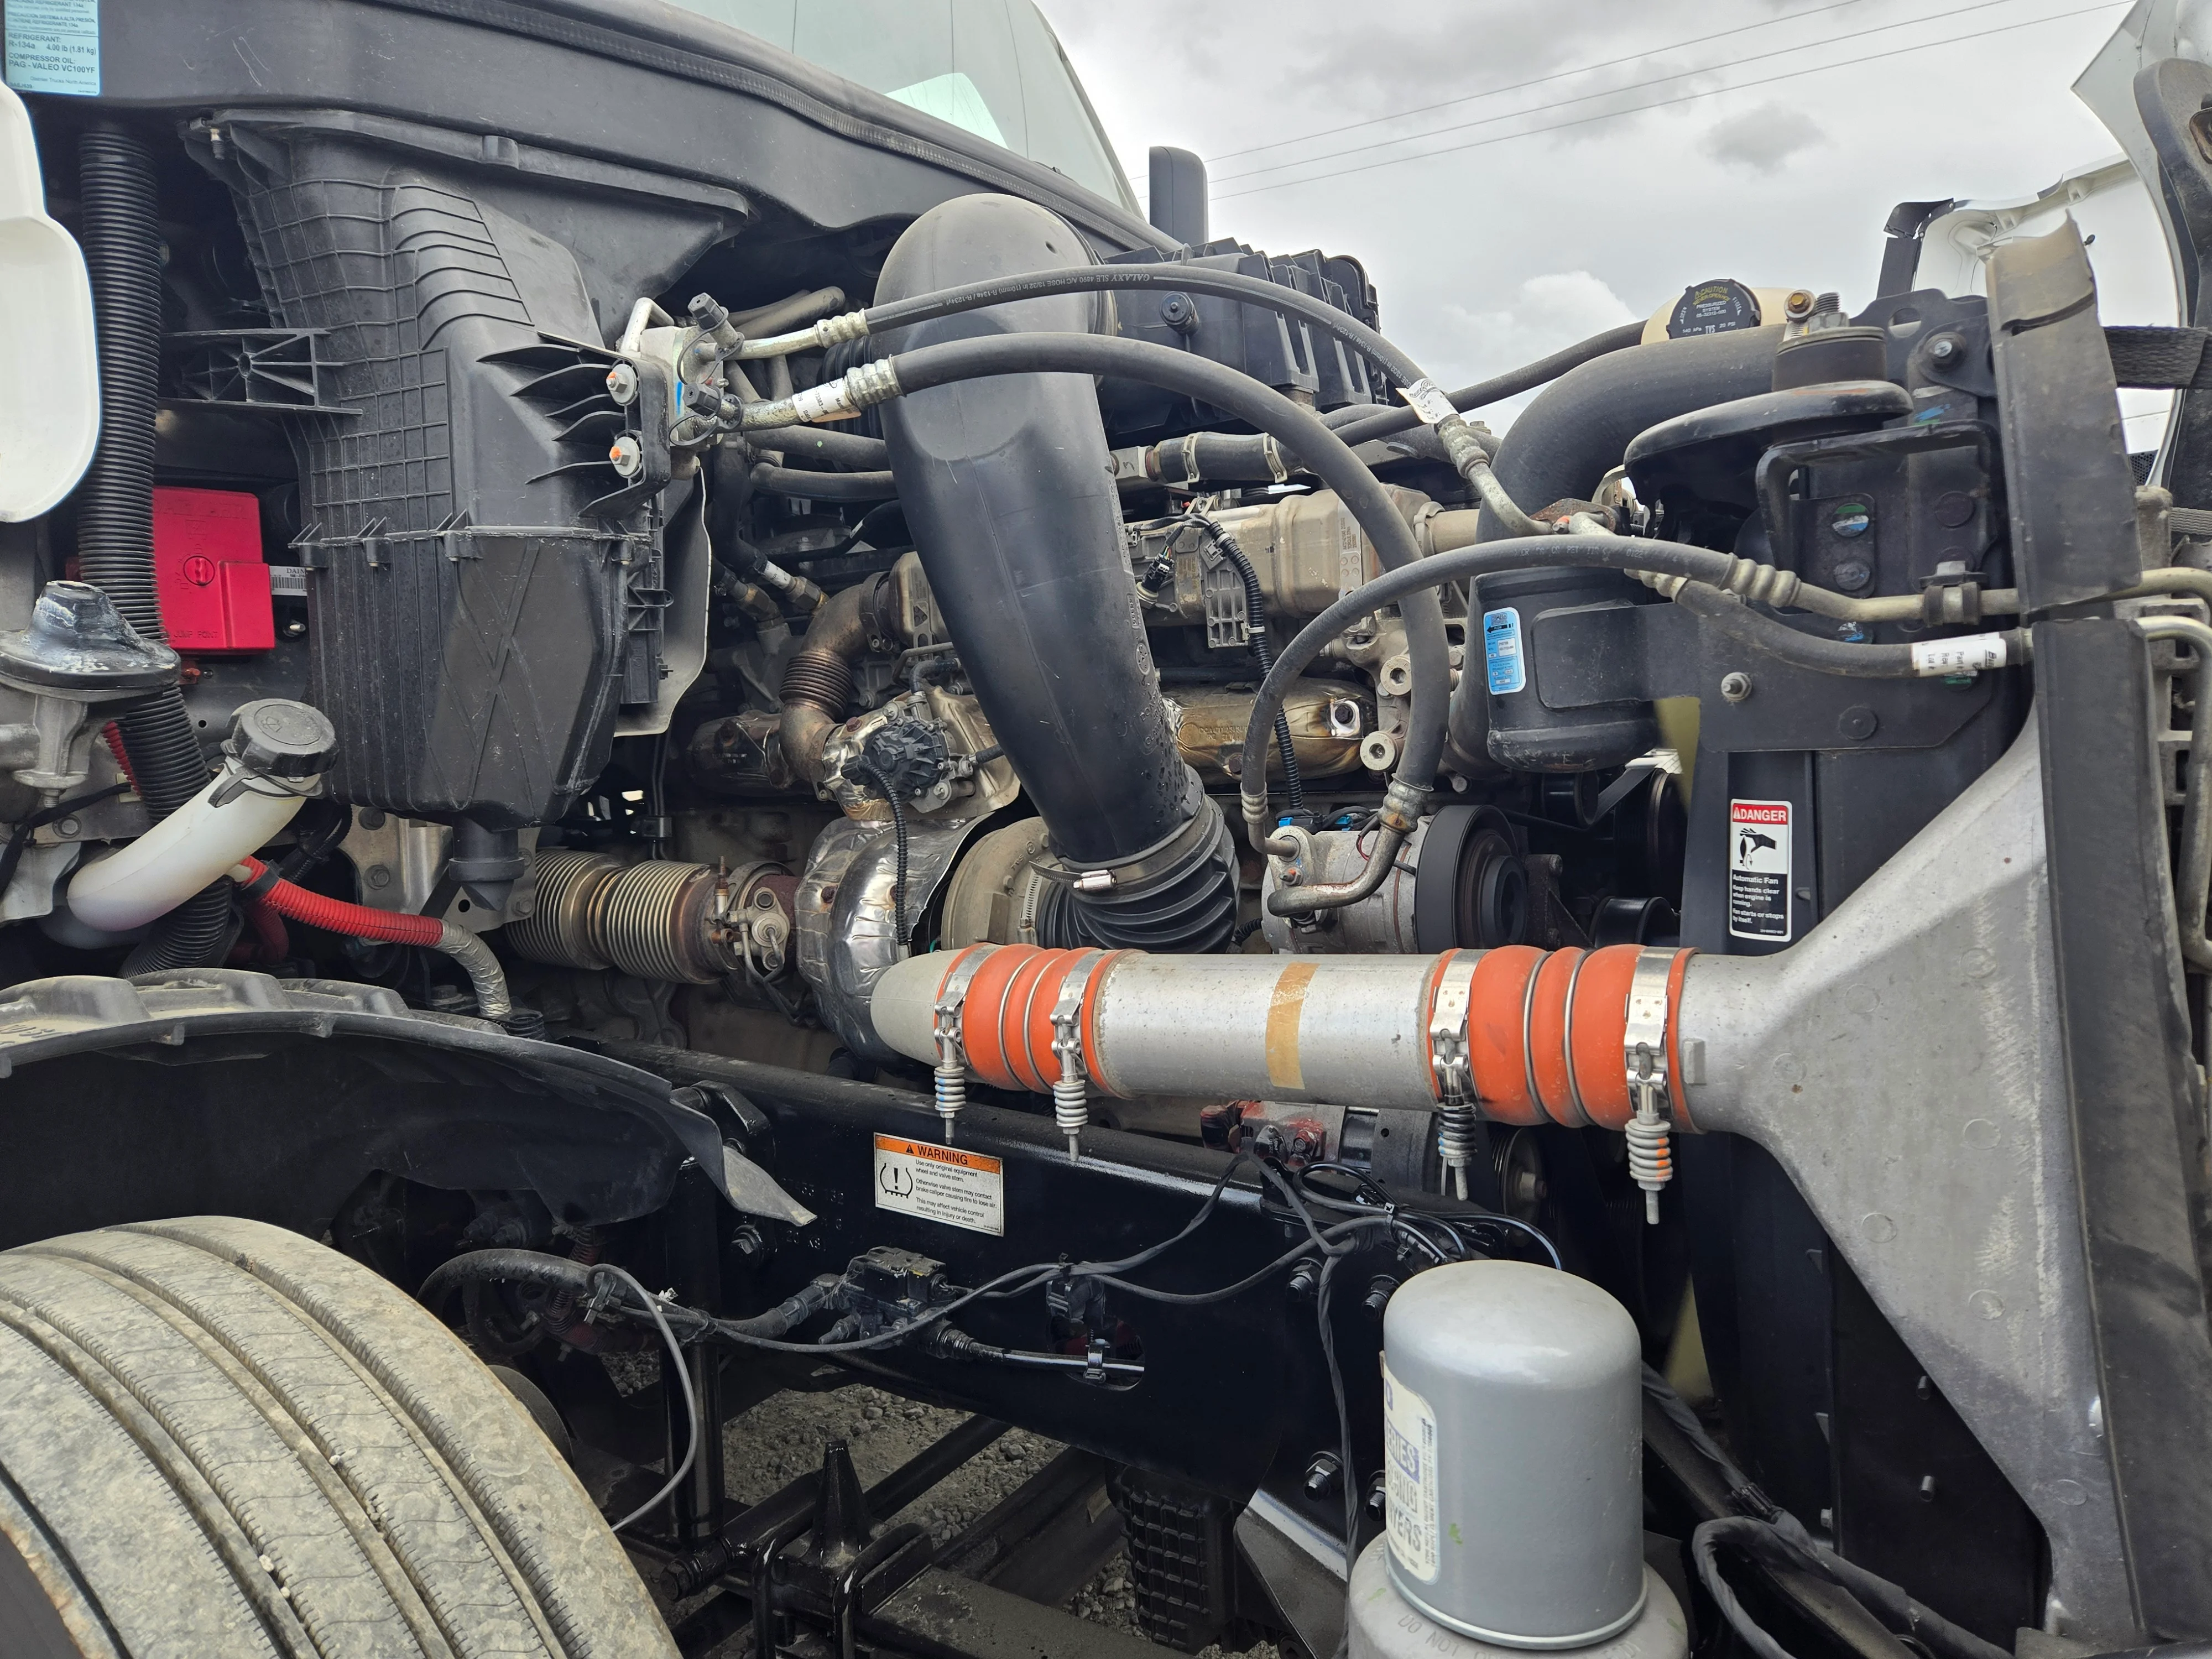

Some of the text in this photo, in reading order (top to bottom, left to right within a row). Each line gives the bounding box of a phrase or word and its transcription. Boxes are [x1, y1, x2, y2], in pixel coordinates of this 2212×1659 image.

[8, 33, 61, 43] REFRIGERANT:
[8, 40, 35, 49] R-134a
[69, 45, 84, 54] (1.81
[86, 46, 96, 55] kg)
[8, 53, 60, 63] COMPRESSOR
[8, 59, 26, 68] PAG
[32, 62, 59, 71] VALEO
[61, 64, 95, 73] VC100YF
[1046, 278, 1065, 287] HOSE
[1066, 276, 1077, 285] A/C
[1079, 276, 1094, 284] 4890
[1095, 274, 1109, 283] SLE
[1111, 273, 1150, 281] GALAXY
[999, 283, 1022, 295] (10mm)
[1029, 281, 1046, 290] 13/32
[977, 288, 997, 299] R-134a
[1401, 374, 1411, 388] OSE
[1740, 809, 1786, 822] DANGER
[917, 1145, 968, 1165] WARNING
[936, 1164, 953, 1172] original
[953, 1168, 978, 1177] equipment
[916, 1178, 938, 1188] Otherwise
[974, 1192, 992, 1200] contact
[916, 1185, 929, 1193] brake
[945, 1193, 963, 1202] causing
[916, 1206, 936, 1215] resulting
[942, 1210, 955, 1219] injury
[961, 1215, 976, 1224] death.
[951, 1204, 967, 1213] vehicle
[967, 1209, 984, 1218] control
